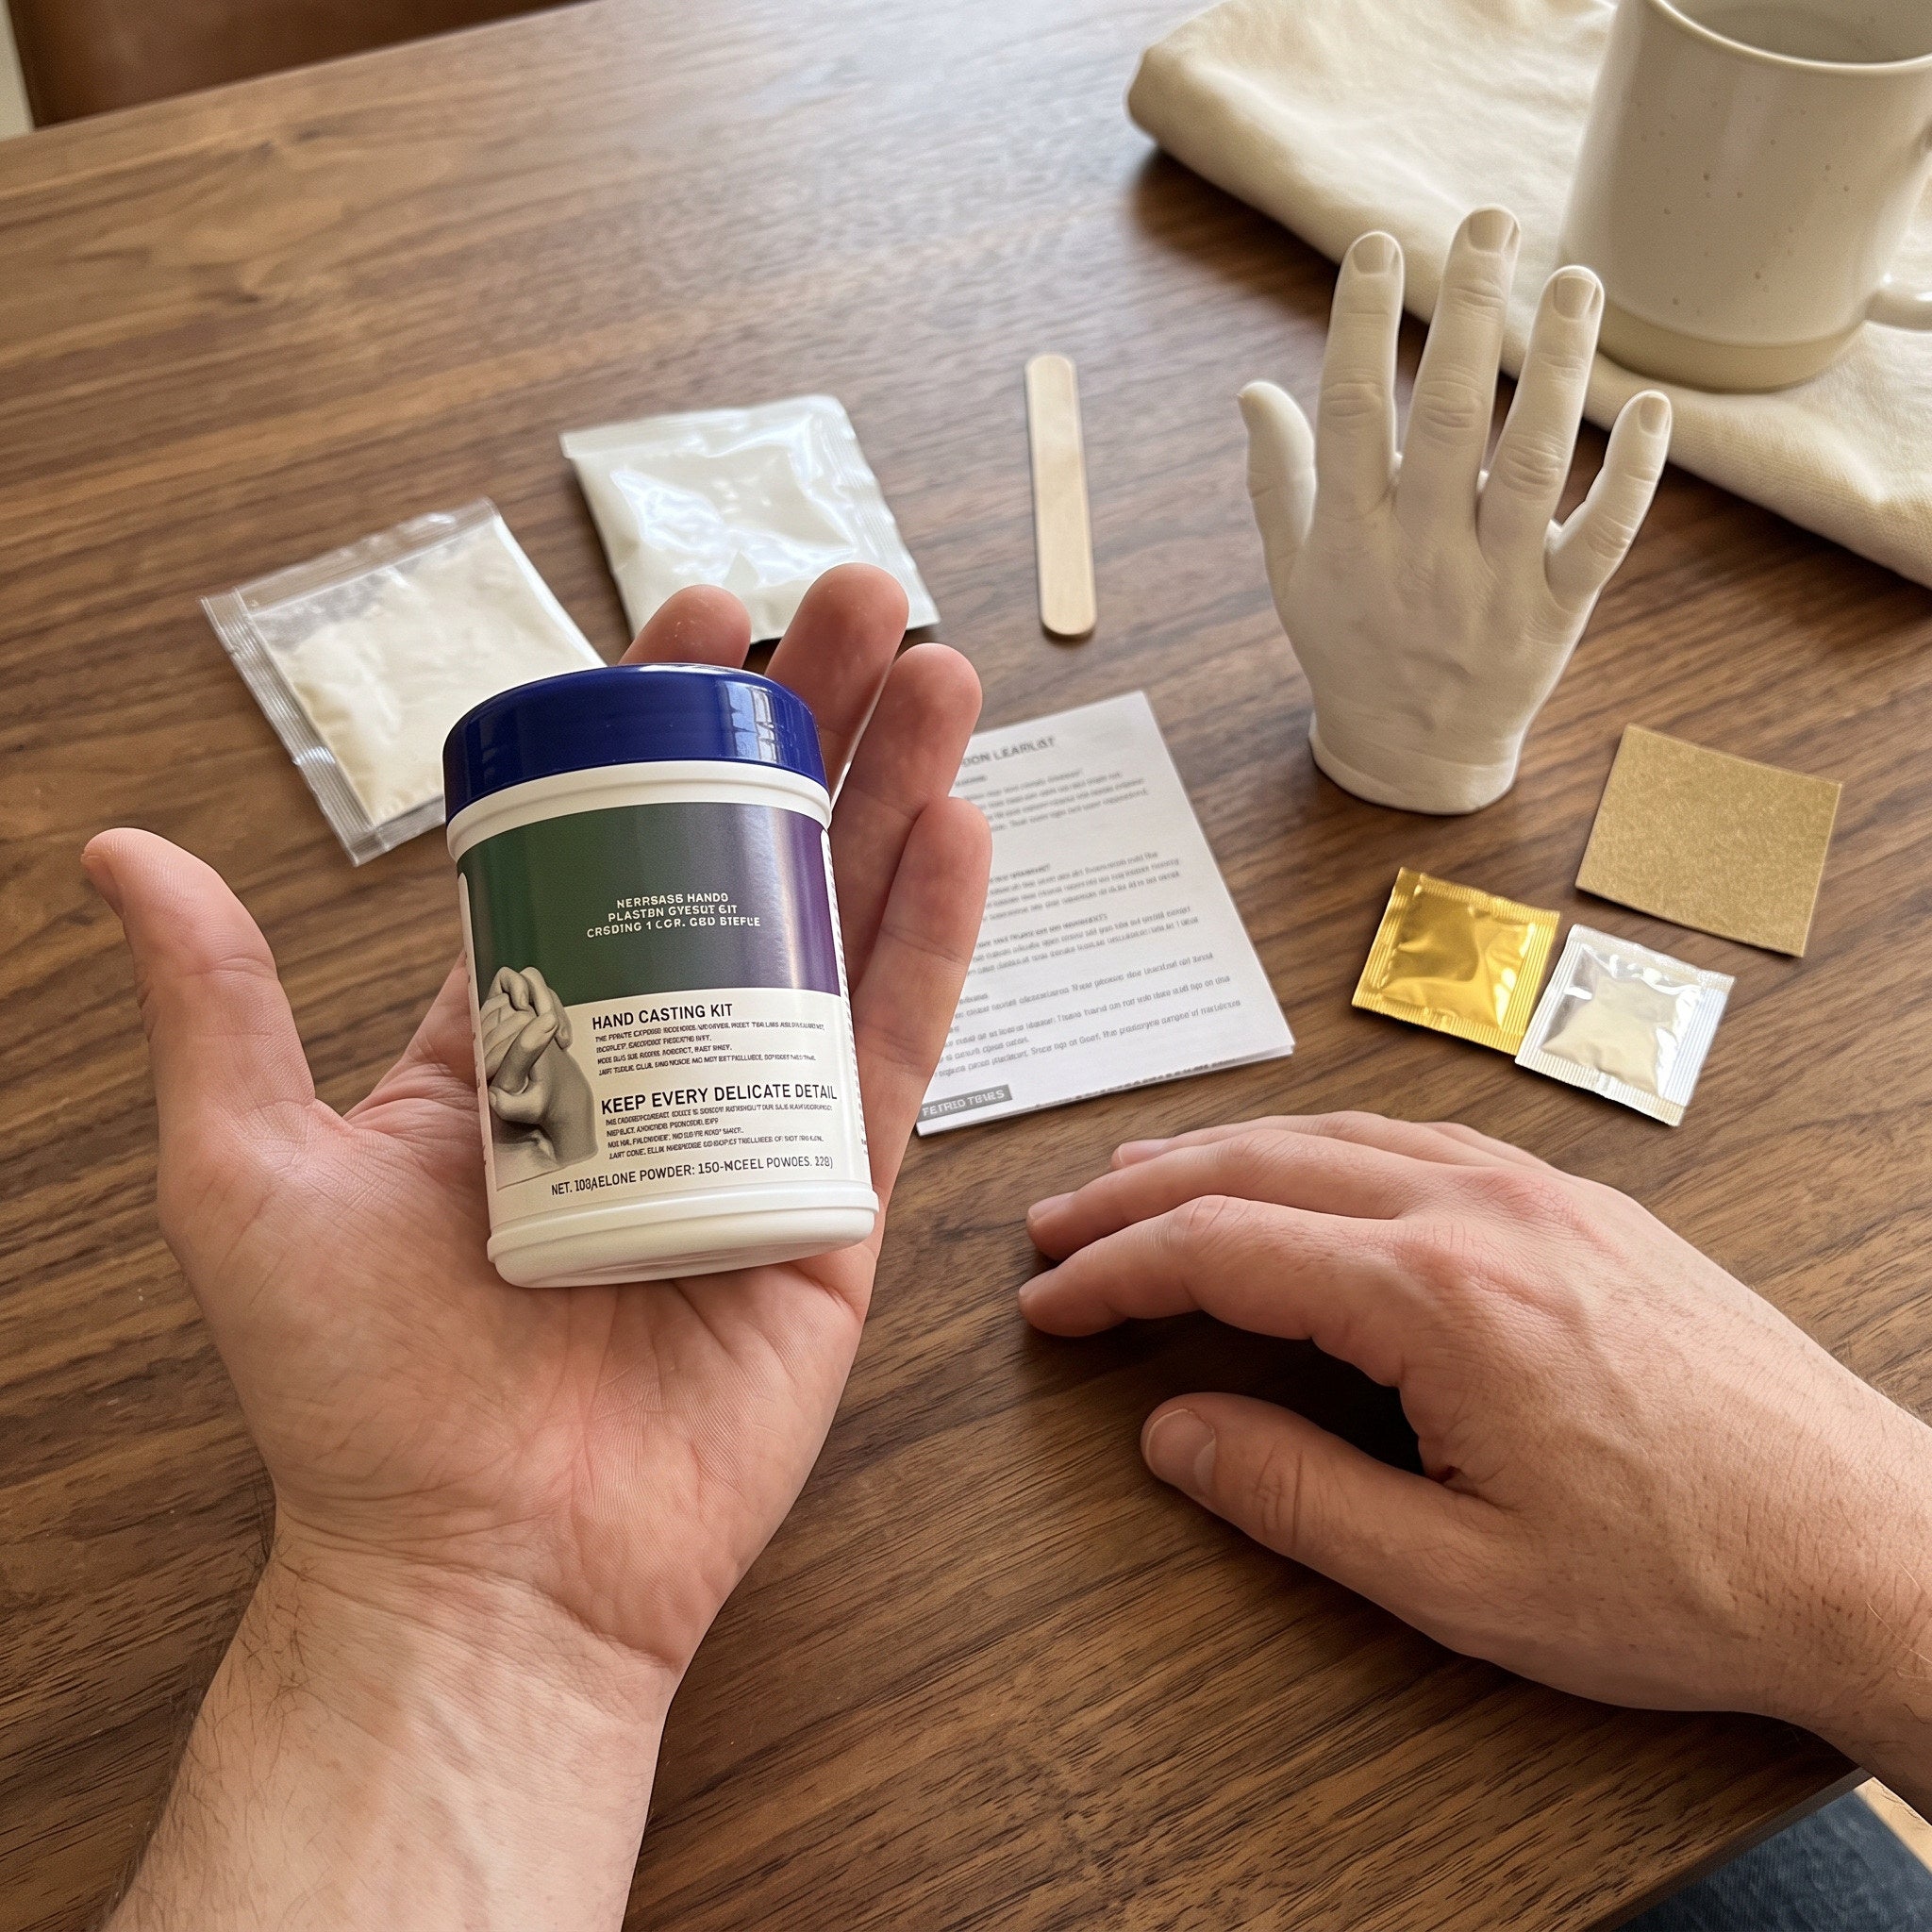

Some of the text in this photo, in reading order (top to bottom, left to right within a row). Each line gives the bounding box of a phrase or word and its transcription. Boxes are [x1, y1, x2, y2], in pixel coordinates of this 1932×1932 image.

[592, 1003, 733, 1030] HAND CASTING KIT
[601, 1094, 646, 1115] KEEP
[652, 1088, 708, 1108] EVERY
[714, 1084, 791, 1101] DELICATE
[795, 1084, 838, 1100] DETAIL
[551, 1181, 573, 1196] NET.
[640, 1164, 695, 1182] POWDER:
